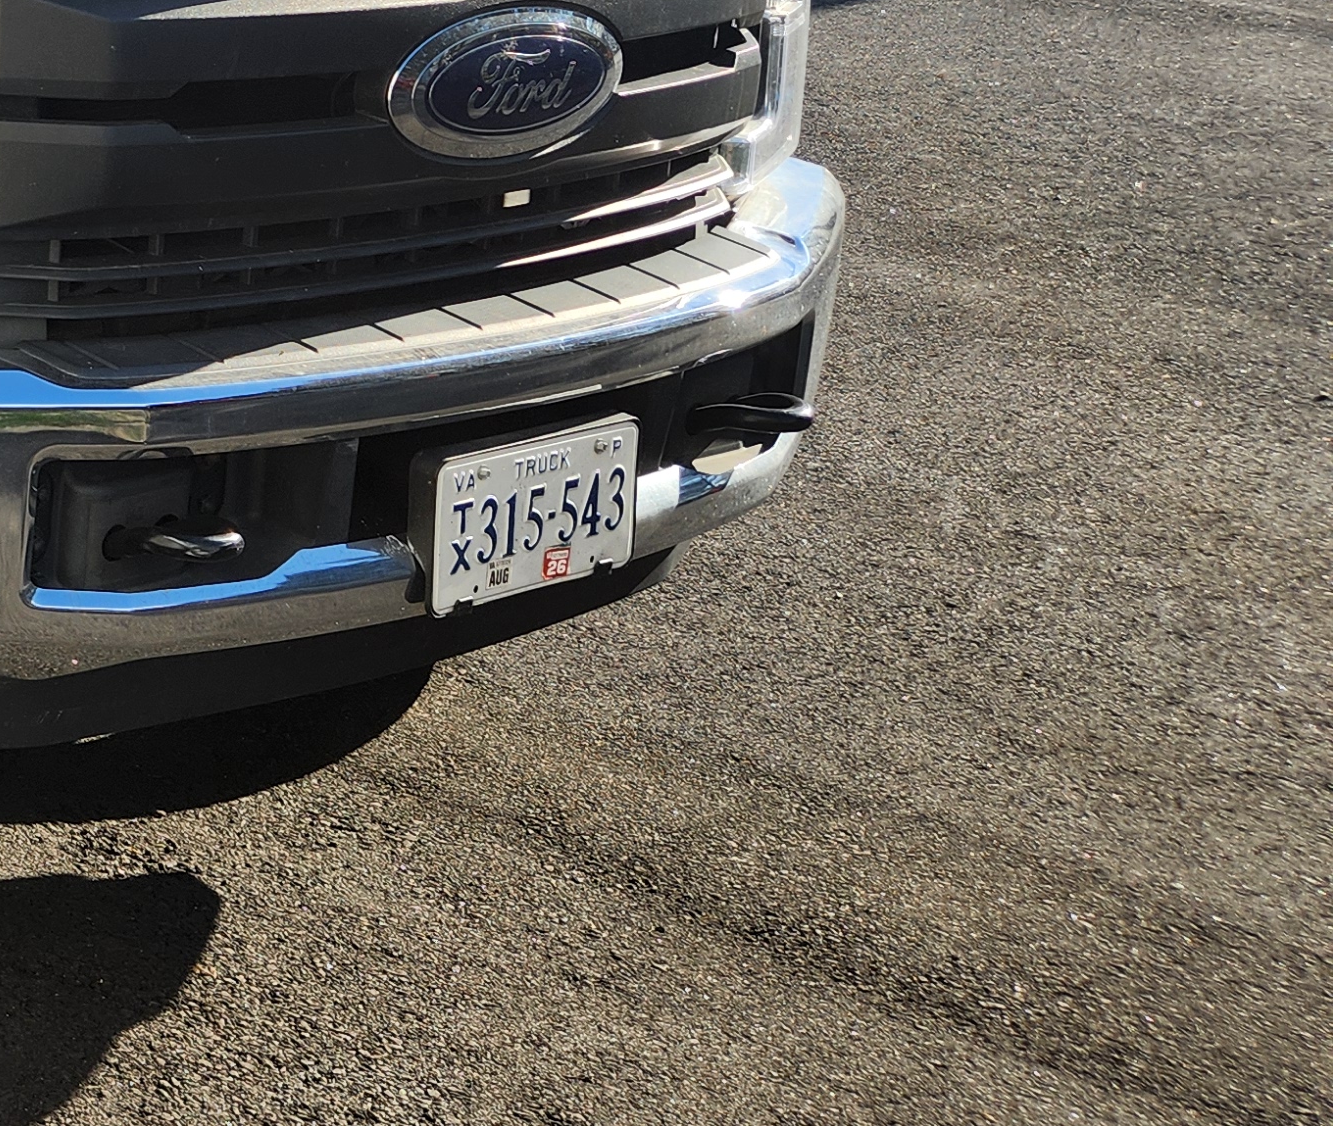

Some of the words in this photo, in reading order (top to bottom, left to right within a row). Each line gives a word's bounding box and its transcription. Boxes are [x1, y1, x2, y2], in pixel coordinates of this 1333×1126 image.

[467, 46, 577, 120] Ford
[453, 469, 477, 493] VA
[515, 446, 572, 480] TRUCK
[610, 436, 623, 458] P
[488, 567, 510, 588] AUG
[546, 559, 568, 576] 26
